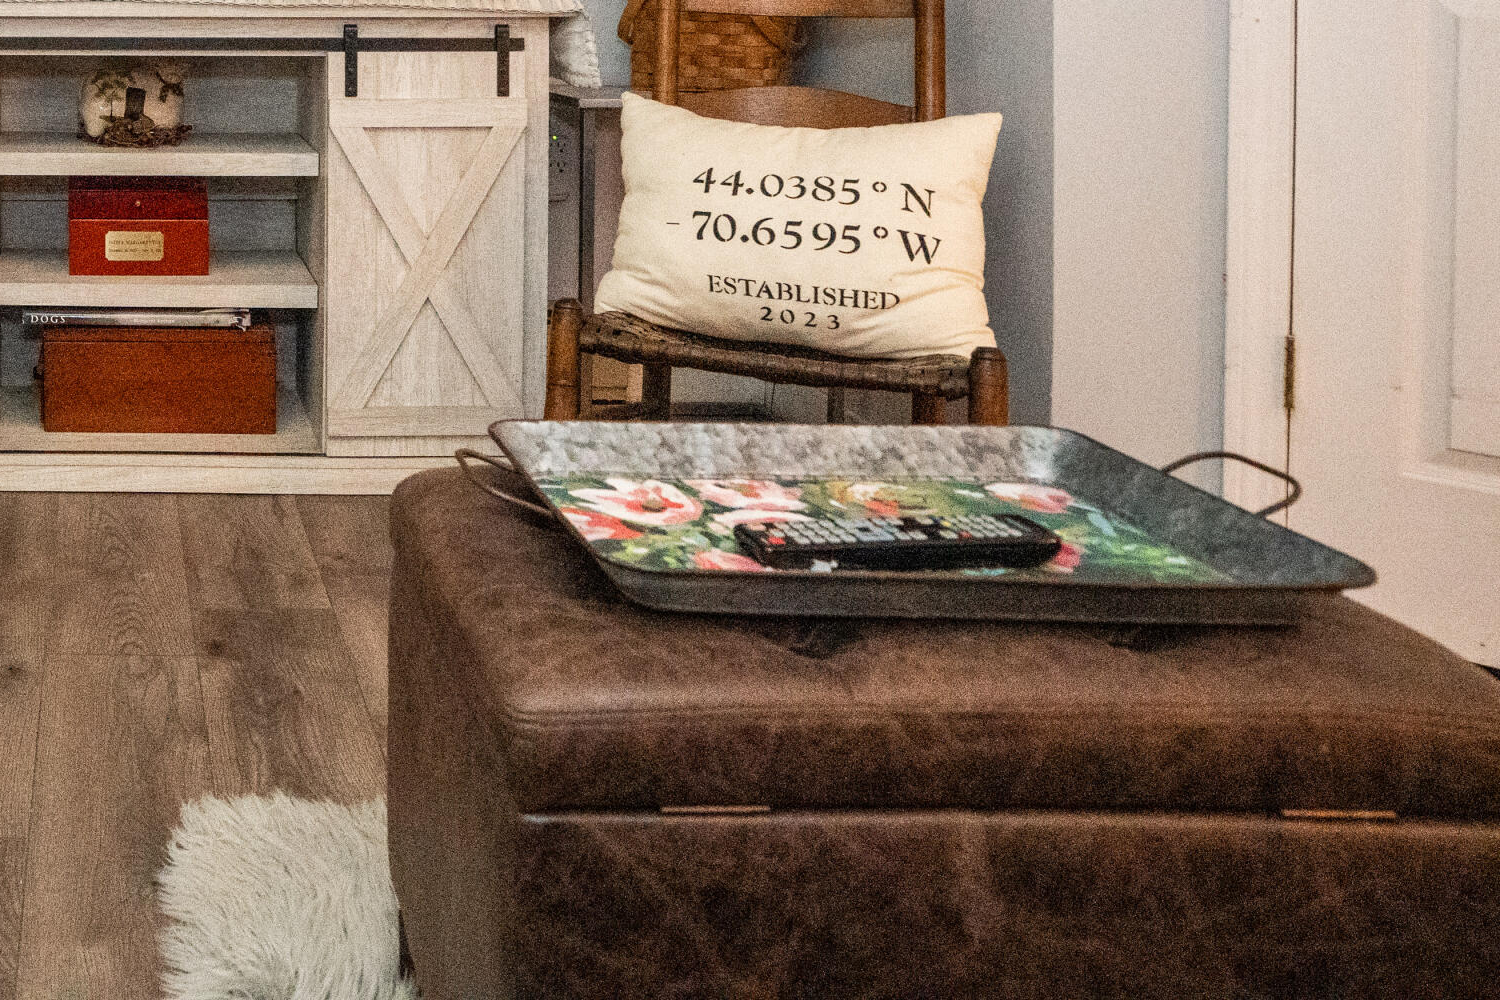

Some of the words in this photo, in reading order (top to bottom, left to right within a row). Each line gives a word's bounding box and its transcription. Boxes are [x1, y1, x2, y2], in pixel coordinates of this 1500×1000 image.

[706, 274, 901, 311] ESTABLISHED
[30, 314, 66, 324] DOGS
[759, 306, 841, 331] 2023
